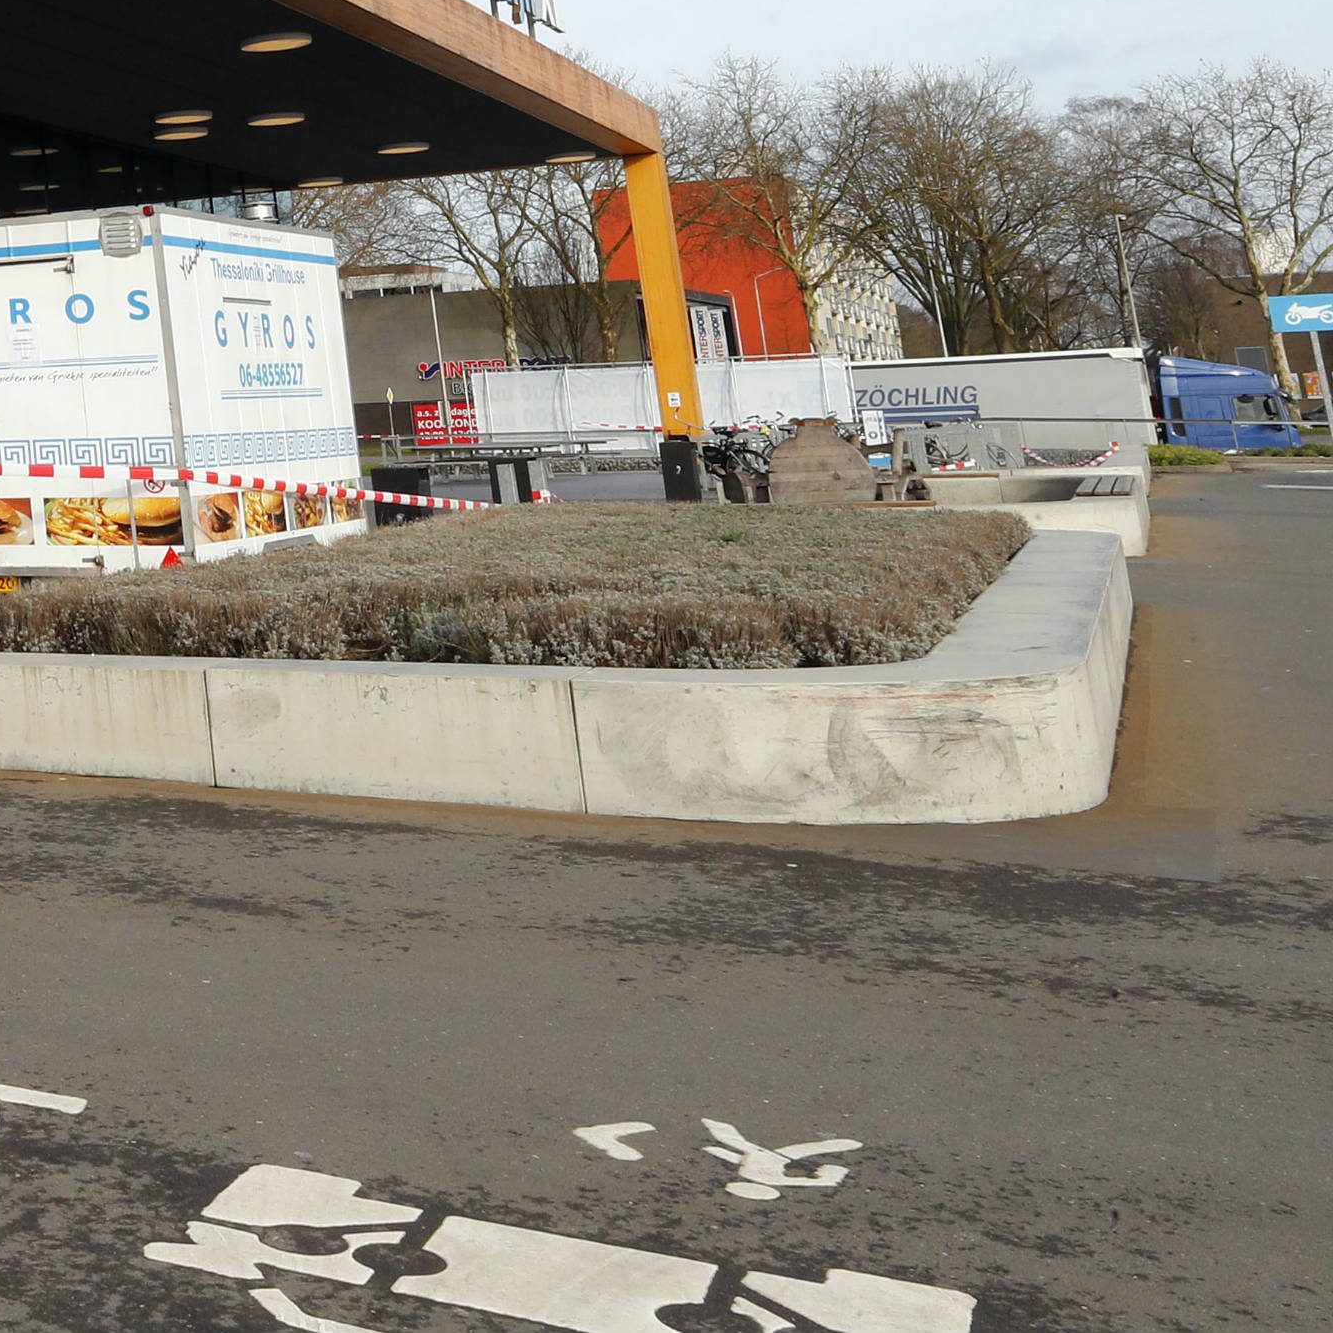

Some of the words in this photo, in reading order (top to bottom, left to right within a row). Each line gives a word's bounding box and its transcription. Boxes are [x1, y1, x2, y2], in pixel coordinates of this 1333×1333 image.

[211, 258, 264, 282] Thessaloniki
[215, 310, 315, 349] GYROS
[856, 385, 977, 407] ZÖCHLING
